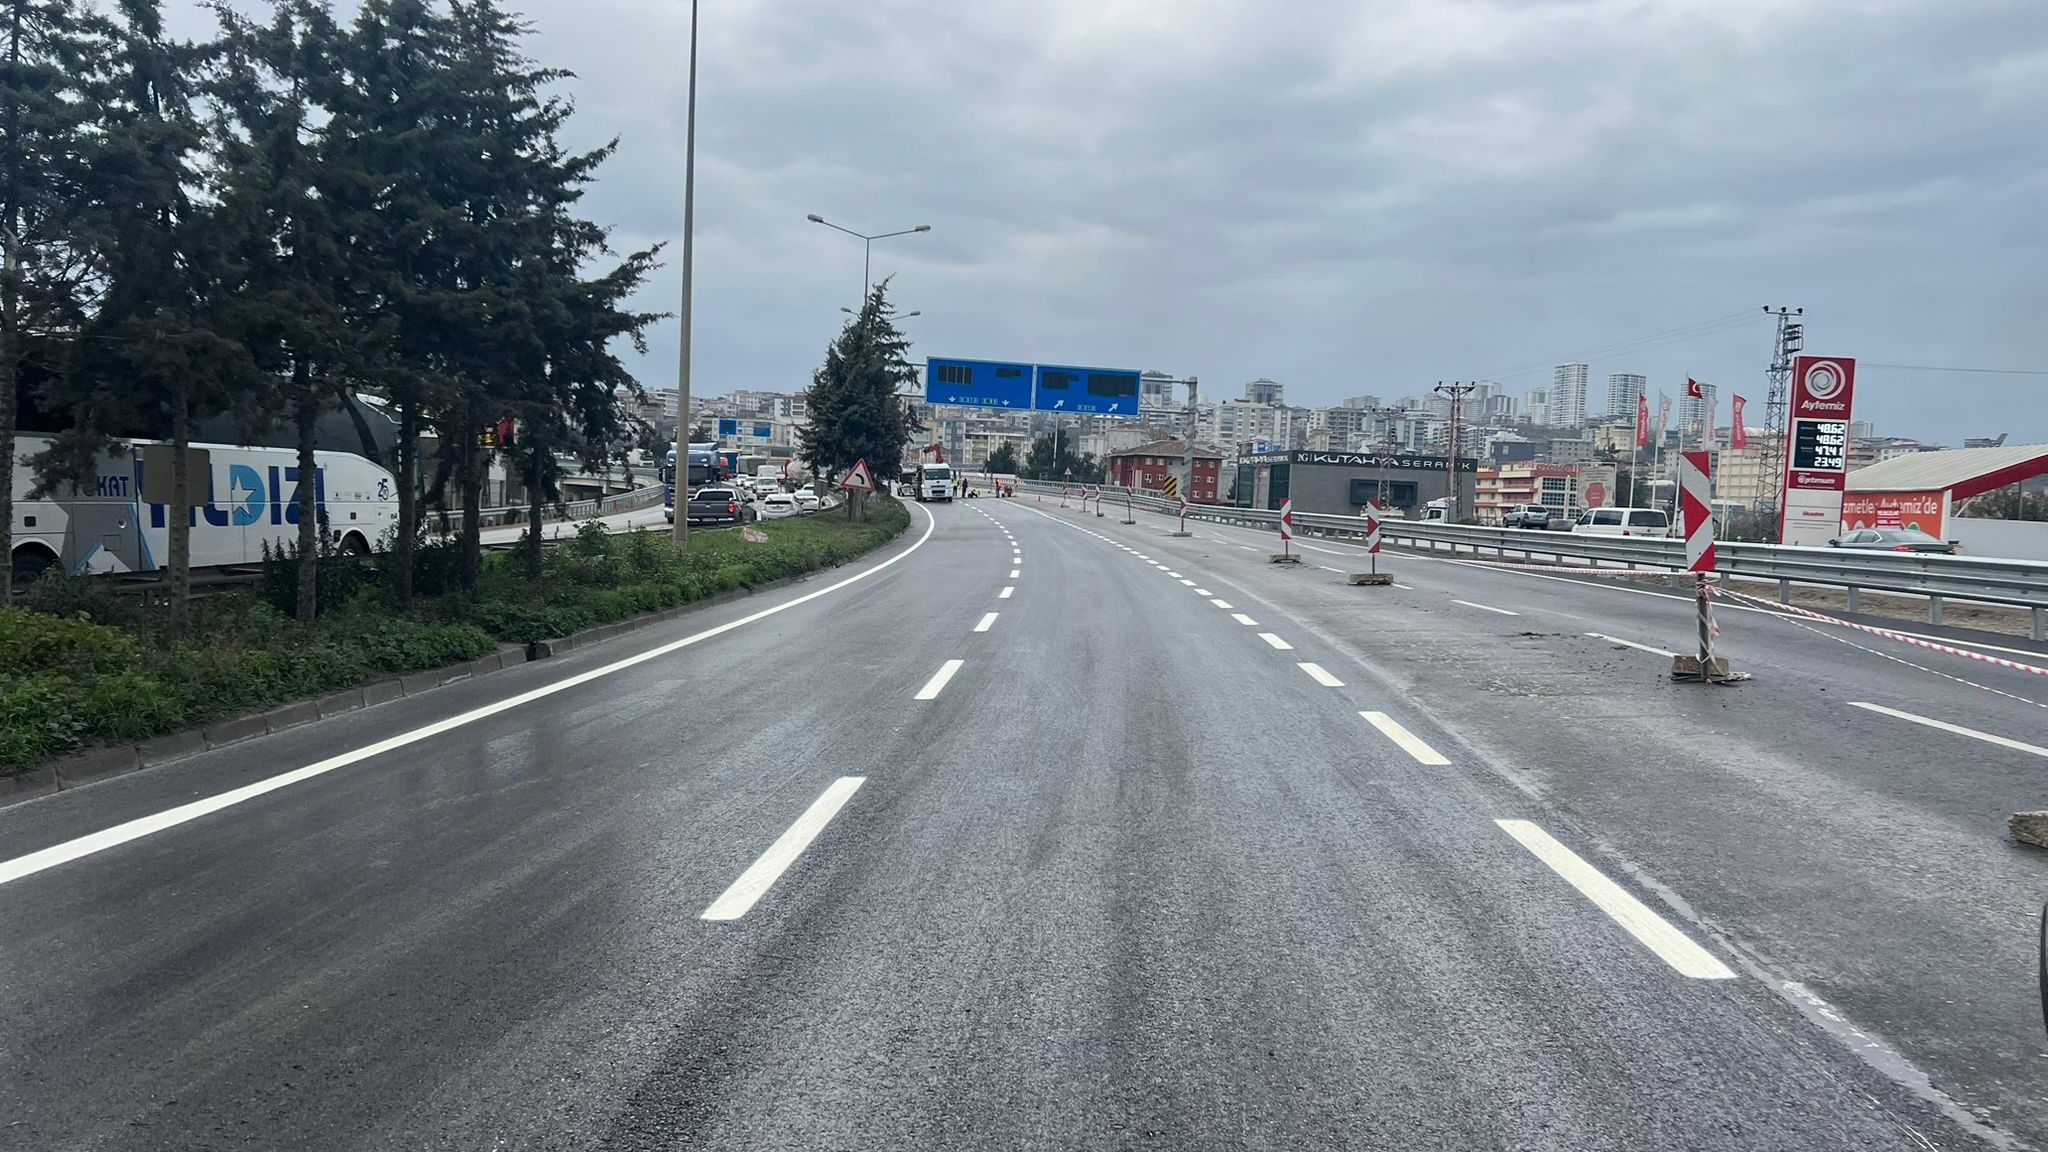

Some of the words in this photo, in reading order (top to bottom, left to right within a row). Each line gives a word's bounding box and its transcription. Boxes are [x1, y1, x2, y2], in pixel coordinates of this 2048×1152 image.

[1801, 400, 1845, 411] Aytemiz
[1402, 459, 1470, 469] SERAK
[71, 476, 129, 497] KAT
[136, 460, 324, 528] LDIZI
